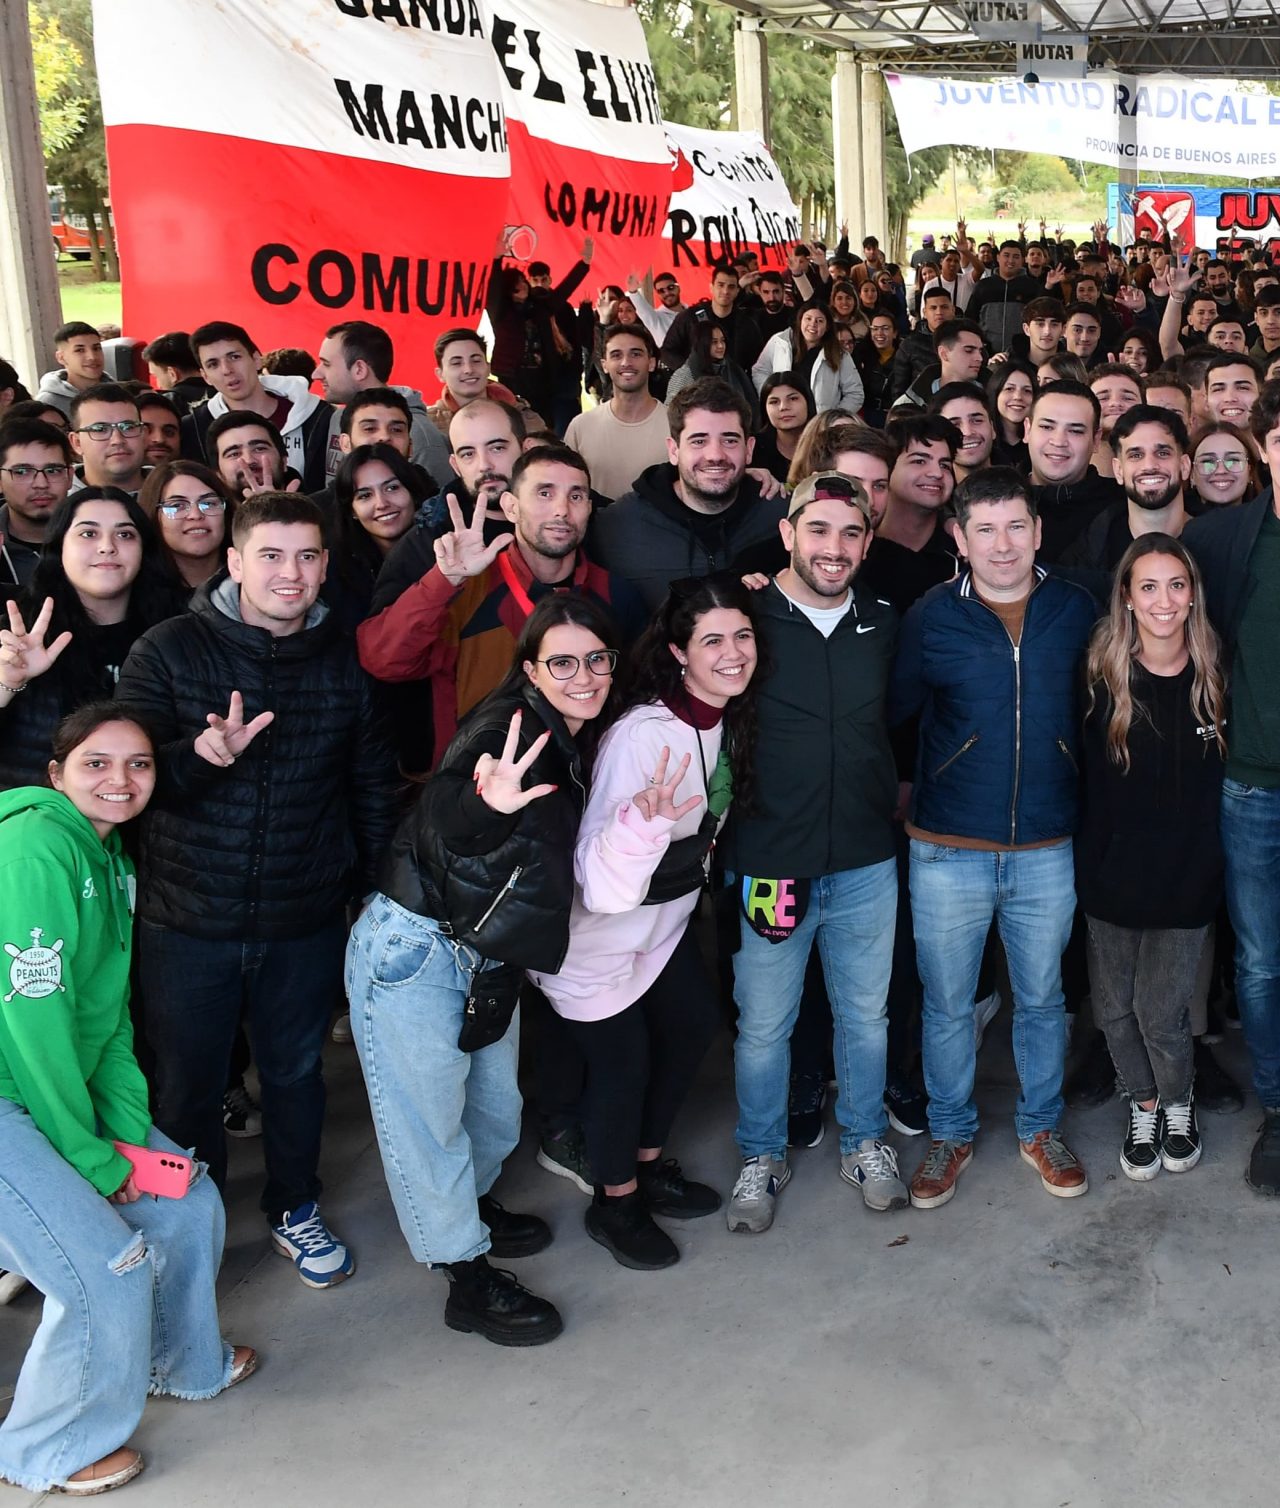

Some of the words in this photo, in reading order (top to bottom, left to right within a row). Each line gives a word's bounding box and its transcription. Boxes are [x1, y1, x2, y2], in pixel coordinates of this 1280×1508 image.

[491, 14, 565, 104] EL
[935, 81, 1105, 111] JUVENTUD
[1114, 84, 1257, 125] RADICAL
[1086, 137, 1149, 158] PROVINCIA
[1153, 145, 1170, 159] DE
[1175, 148, 1231, 164] BUENOS
[1236, 151, 1277, 165] AIRES
[544, 180, 657, 237] COMUNA
[251, 243, 489, 318] COMUNA
[16, 965, 58, 980] PEANUTS
